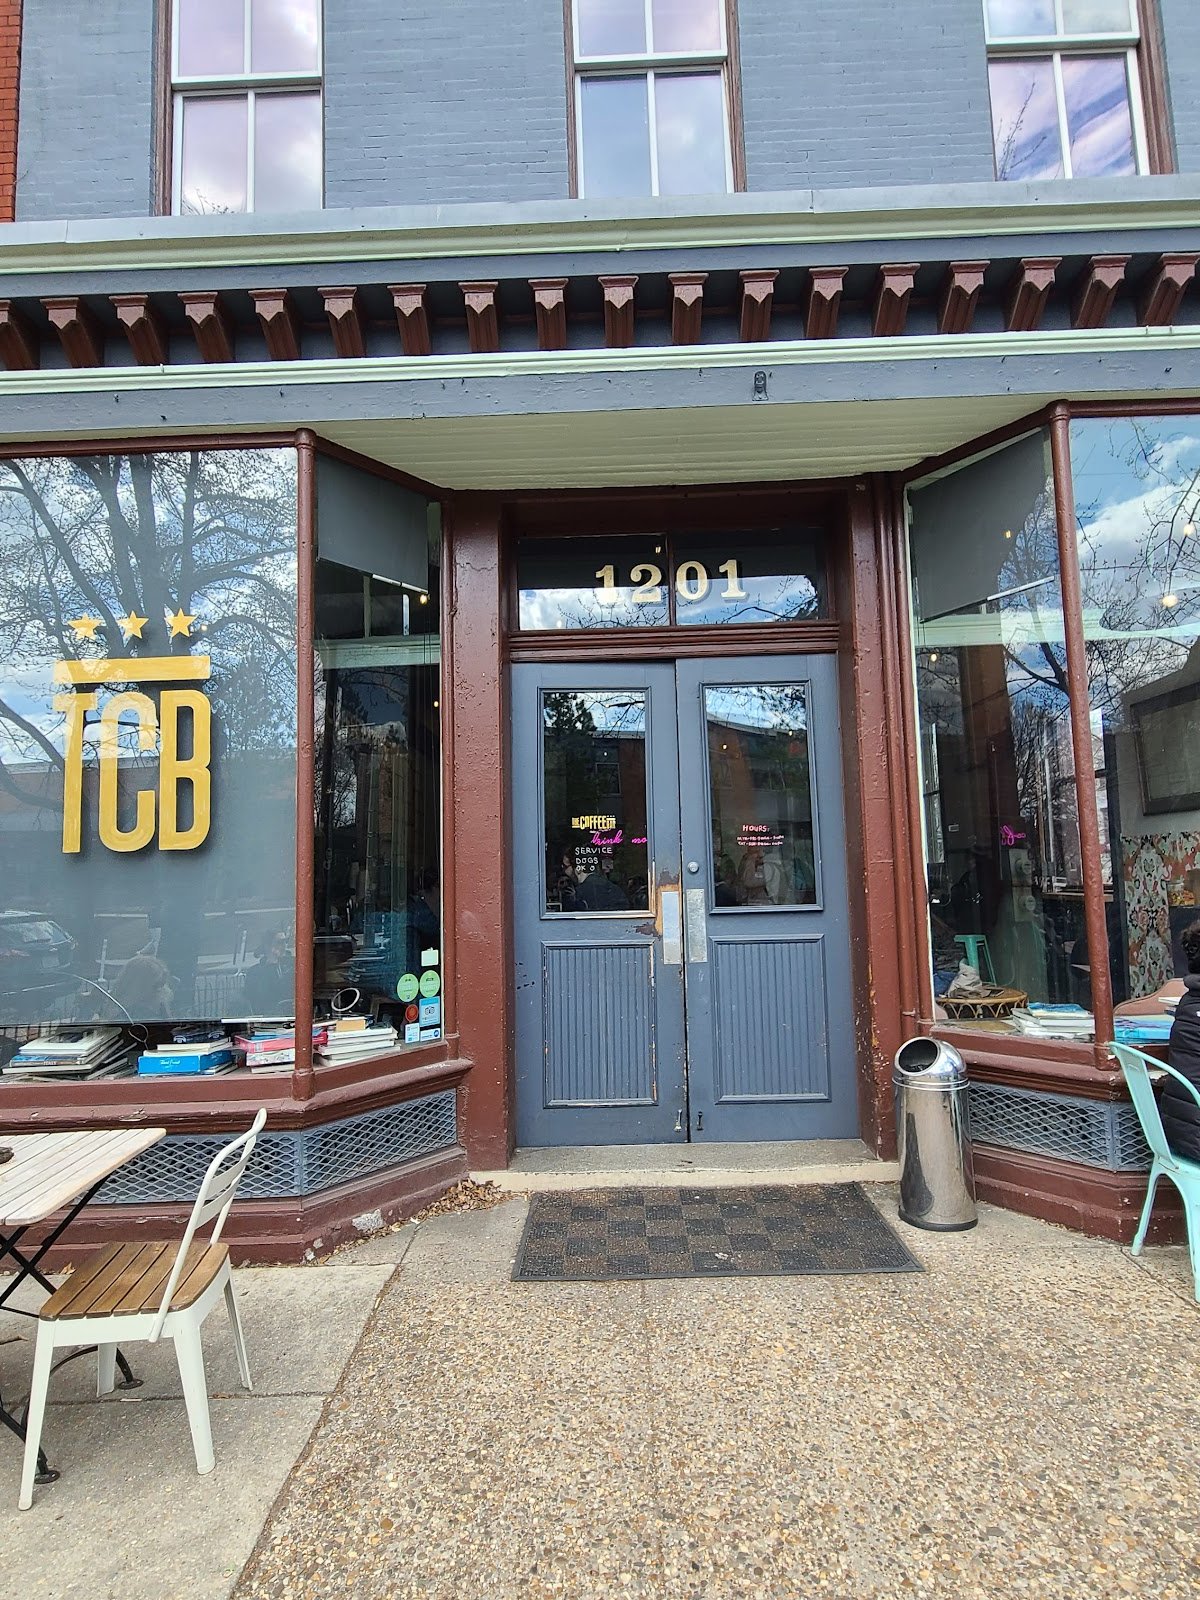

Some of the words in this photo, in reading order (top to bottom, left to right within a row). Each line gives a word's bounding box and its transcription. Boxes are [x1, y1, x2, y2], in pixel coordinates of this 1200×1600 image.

[595, 559, 748, 604] 1201
[53, 689, 211, 853] TCB
[580, 816, 608, 829] COFFEE
[575, 847, 613, 855] SERVICE
[575, 857, 599, 865] DOGS
